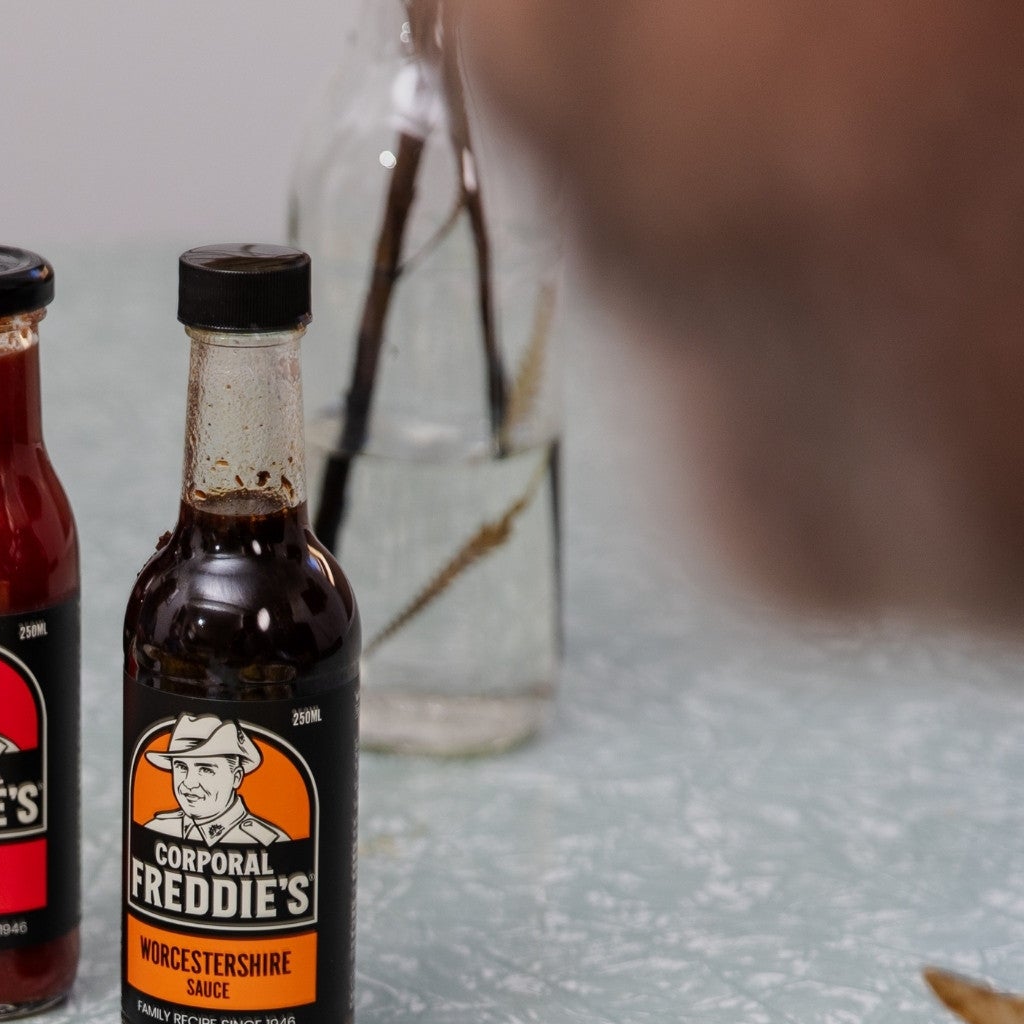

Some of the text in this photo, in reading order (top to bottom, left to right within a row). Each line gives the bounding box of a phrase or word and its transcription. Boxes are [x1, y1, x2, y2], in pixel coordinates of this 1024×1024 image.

[19, 622, 48, 640] 250ML
[292, 709, 322, 726] 250ML
[155, 842, 274, 876] CORPORAL
[132, 856, 310, 919] FREDDIE'S
[140, 935, 292, 977] WORCESTERSHIRE
[187, 979, 230, 999] SAUCE
[137, 1000, 171, 1022] FAMILY
